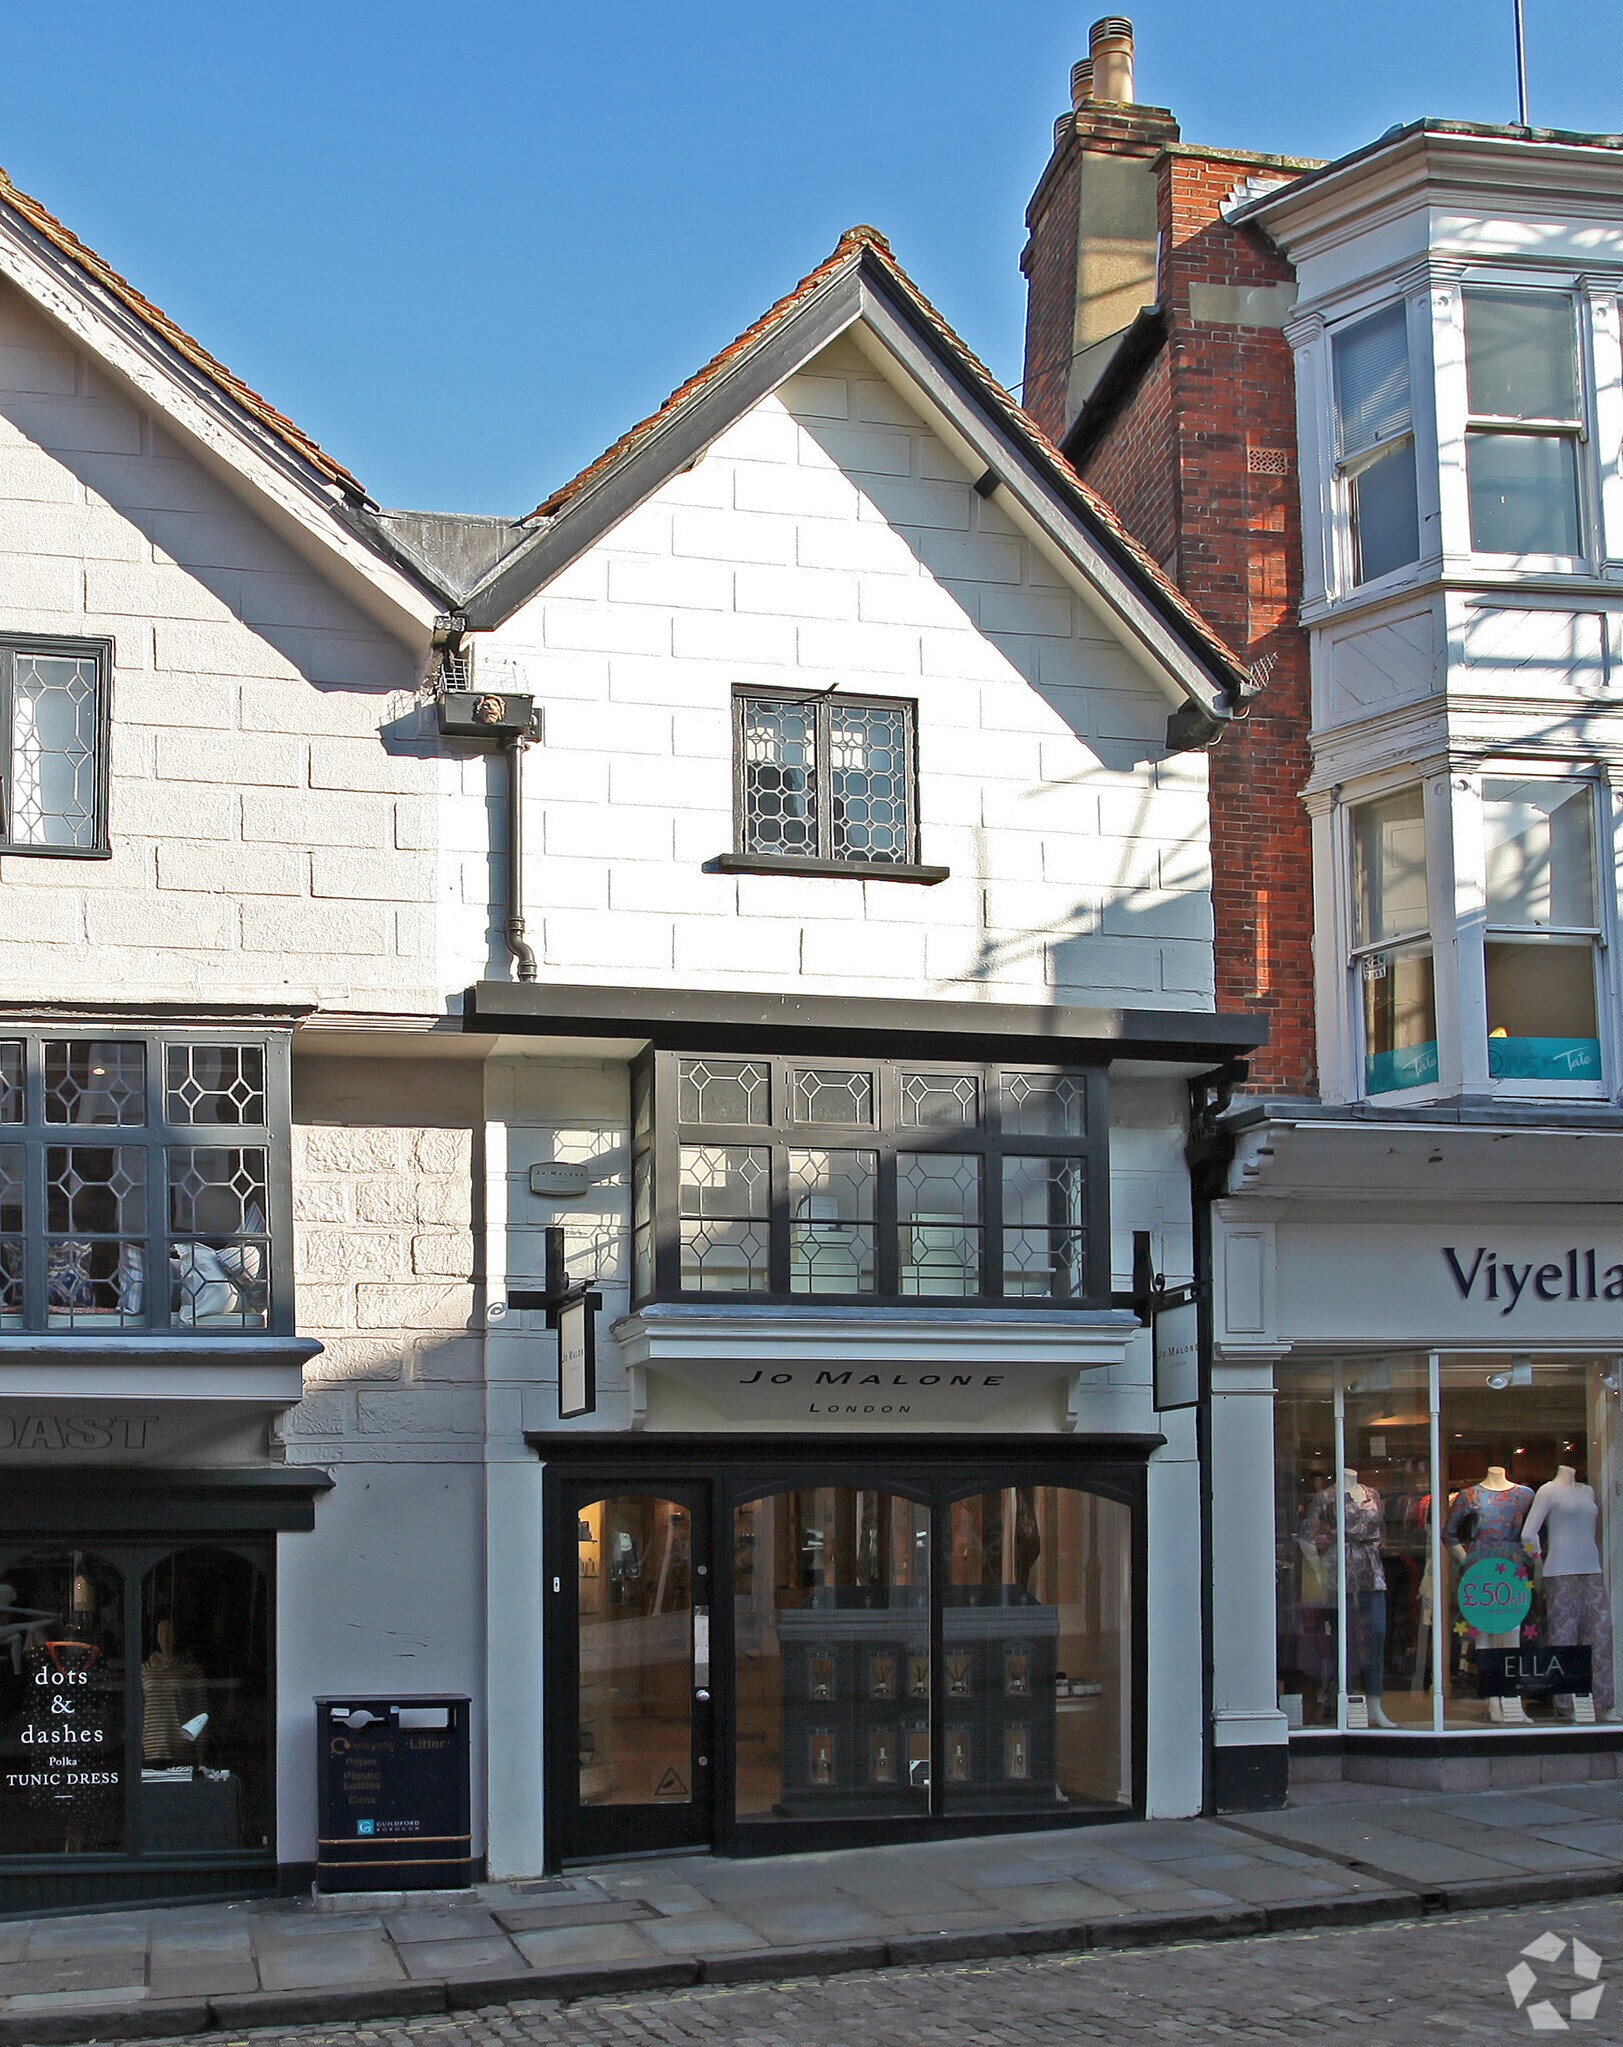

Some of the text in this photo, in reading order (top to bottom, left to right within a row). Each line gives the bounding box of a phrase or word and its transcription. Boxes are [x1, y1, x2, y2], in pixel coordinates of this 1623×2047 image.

[1402, 1050, 1438, 1077] Tate
[1553, 1046, 1592, 1072] Tate
[1441, 1247, 1623, 1315] Viyella
[814, 1371, 1004, 1386] MALONE
[809, 1403, 911, 1413] LONDON
[1464, 1582, 1511, 1606] £50
[35, 1666, 88, 1685] dots
[1504, 1655, 1564, 1678] ELLA
[51, 1694, 75, 1714] &
[21, 1724, 104, 1744] dashes
[409, 1738, 446, 1750] Litter
[49, 1757, 78, 1766] Polka
[6, 1772, 119, 1786] TUNIC DRESS
